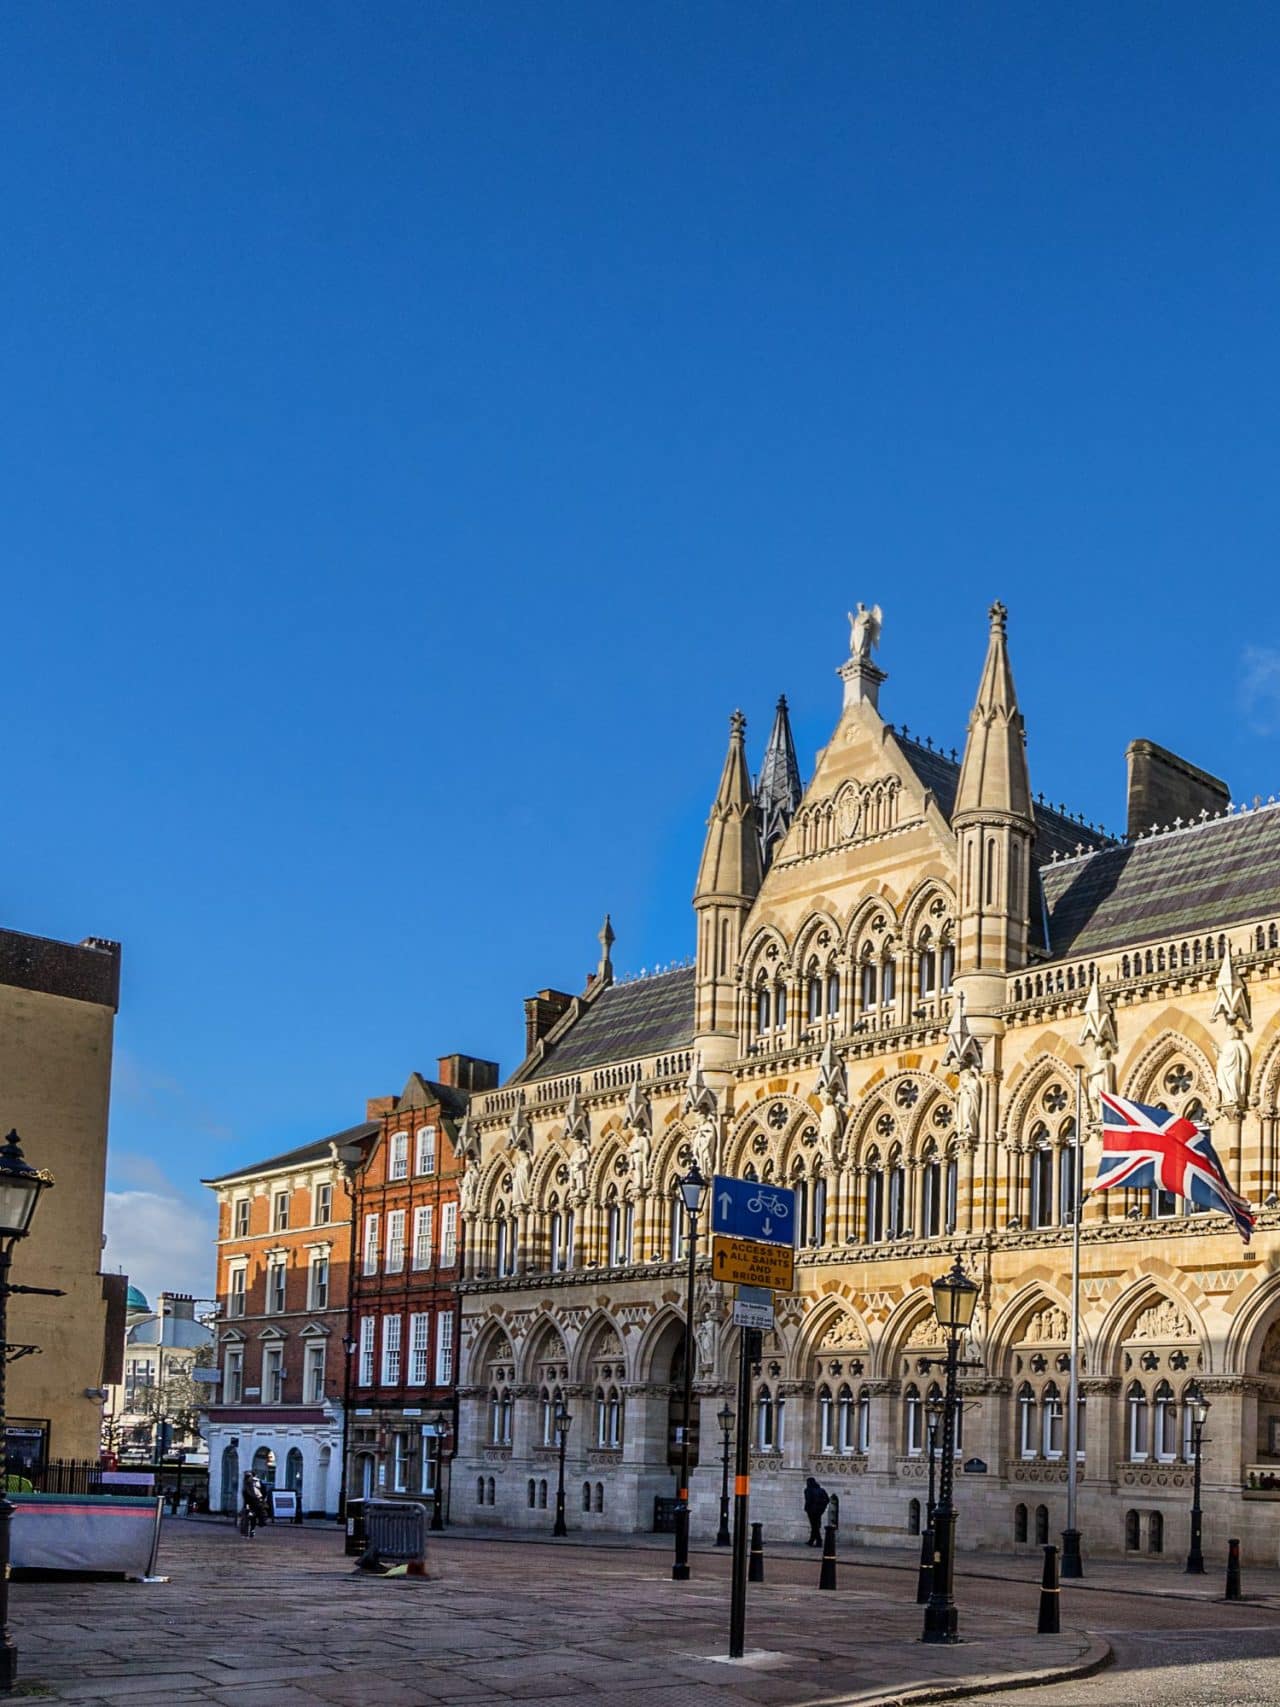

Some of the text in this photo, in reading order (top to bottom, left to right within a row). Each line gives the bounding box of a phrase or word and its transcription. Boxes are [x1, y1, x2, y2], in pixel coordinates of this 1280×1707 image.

[731, 1243, 789, 1259] ACCESS TO
[730, 1252, 789, 1268] ALL SAINTS
[749, 1264, 771, 1274] AND
[732, 1270, 787, 1286] BRIDGE ST
